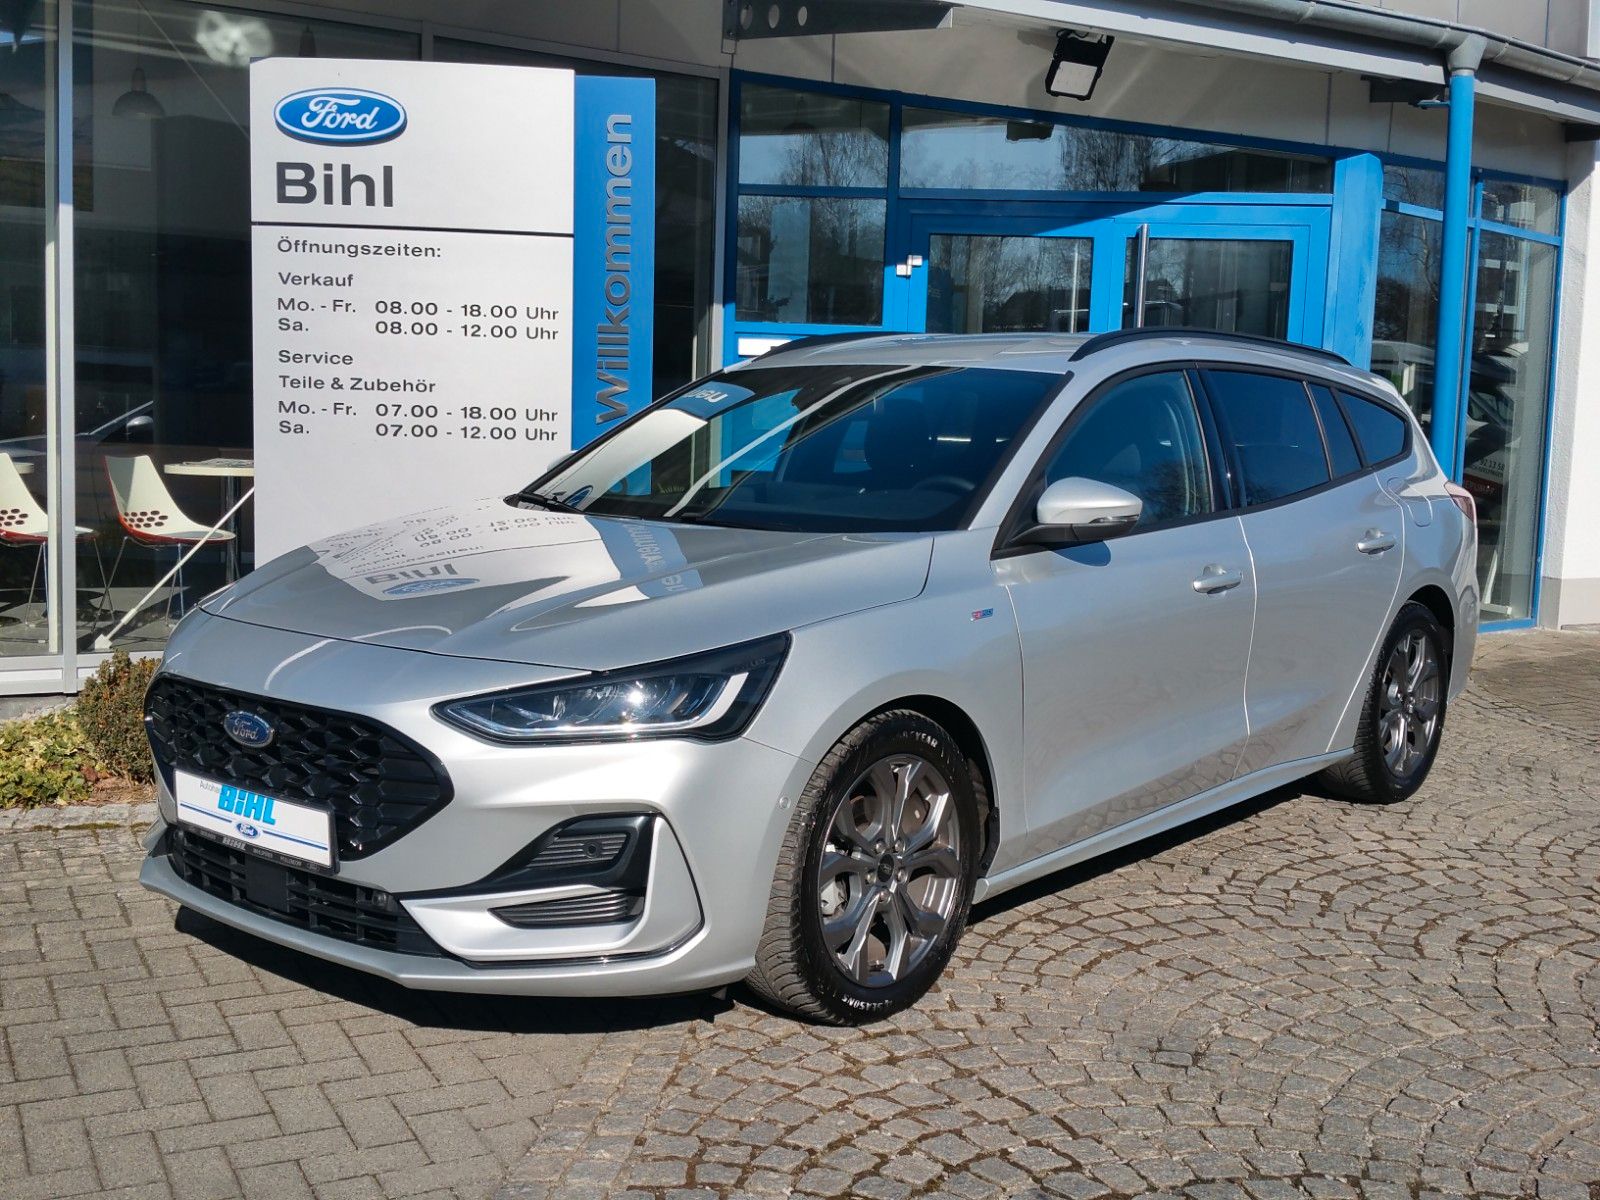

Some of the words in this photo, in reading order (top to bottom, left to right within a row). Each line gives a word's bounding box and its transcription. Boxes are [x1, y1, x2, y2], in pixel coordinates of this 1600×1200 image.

[275, 161, 394, 208] Bihl
[277, 235, 441, 258] Öffnungszeiten:
[277, 271, 354, 287] Verkauf
[594, 112, 633, 426] Willkommen
[277, 297, 315, 312] Mo.
[332, 299, 356, 313] Fr.
[374, 300, 438, 316] 08.00
[460, 303, 518, 319] 18.00
[526, 306, 559, 320] Uhr
[277, 317, 309, 332] Sa.
[375, 320, 439, 336] 08.00
[460, 323, 518, 339] 12.00
[526, 326, 559, 340] Uhr
[278, 349, 354, 366] Service
[278, 374, 326, 390] Teile
[330, 376, 345, 391] &
[349, 377, 436, 393] Zubehör
[278, 400, 316, 415] Mo.
[333, 402, 357, 416] Fr.
[375, 403, 439, 419] 07.00
[460, 406, 517, 421] 18.00
[525, 408, 559, 422] Uhr
[278, 419, 310, 435] Sa.
[375, 422, 438, 438] 07.00
[460, 425, 517, 441] 12.00
[525, 427, 558, 442] Uhr
